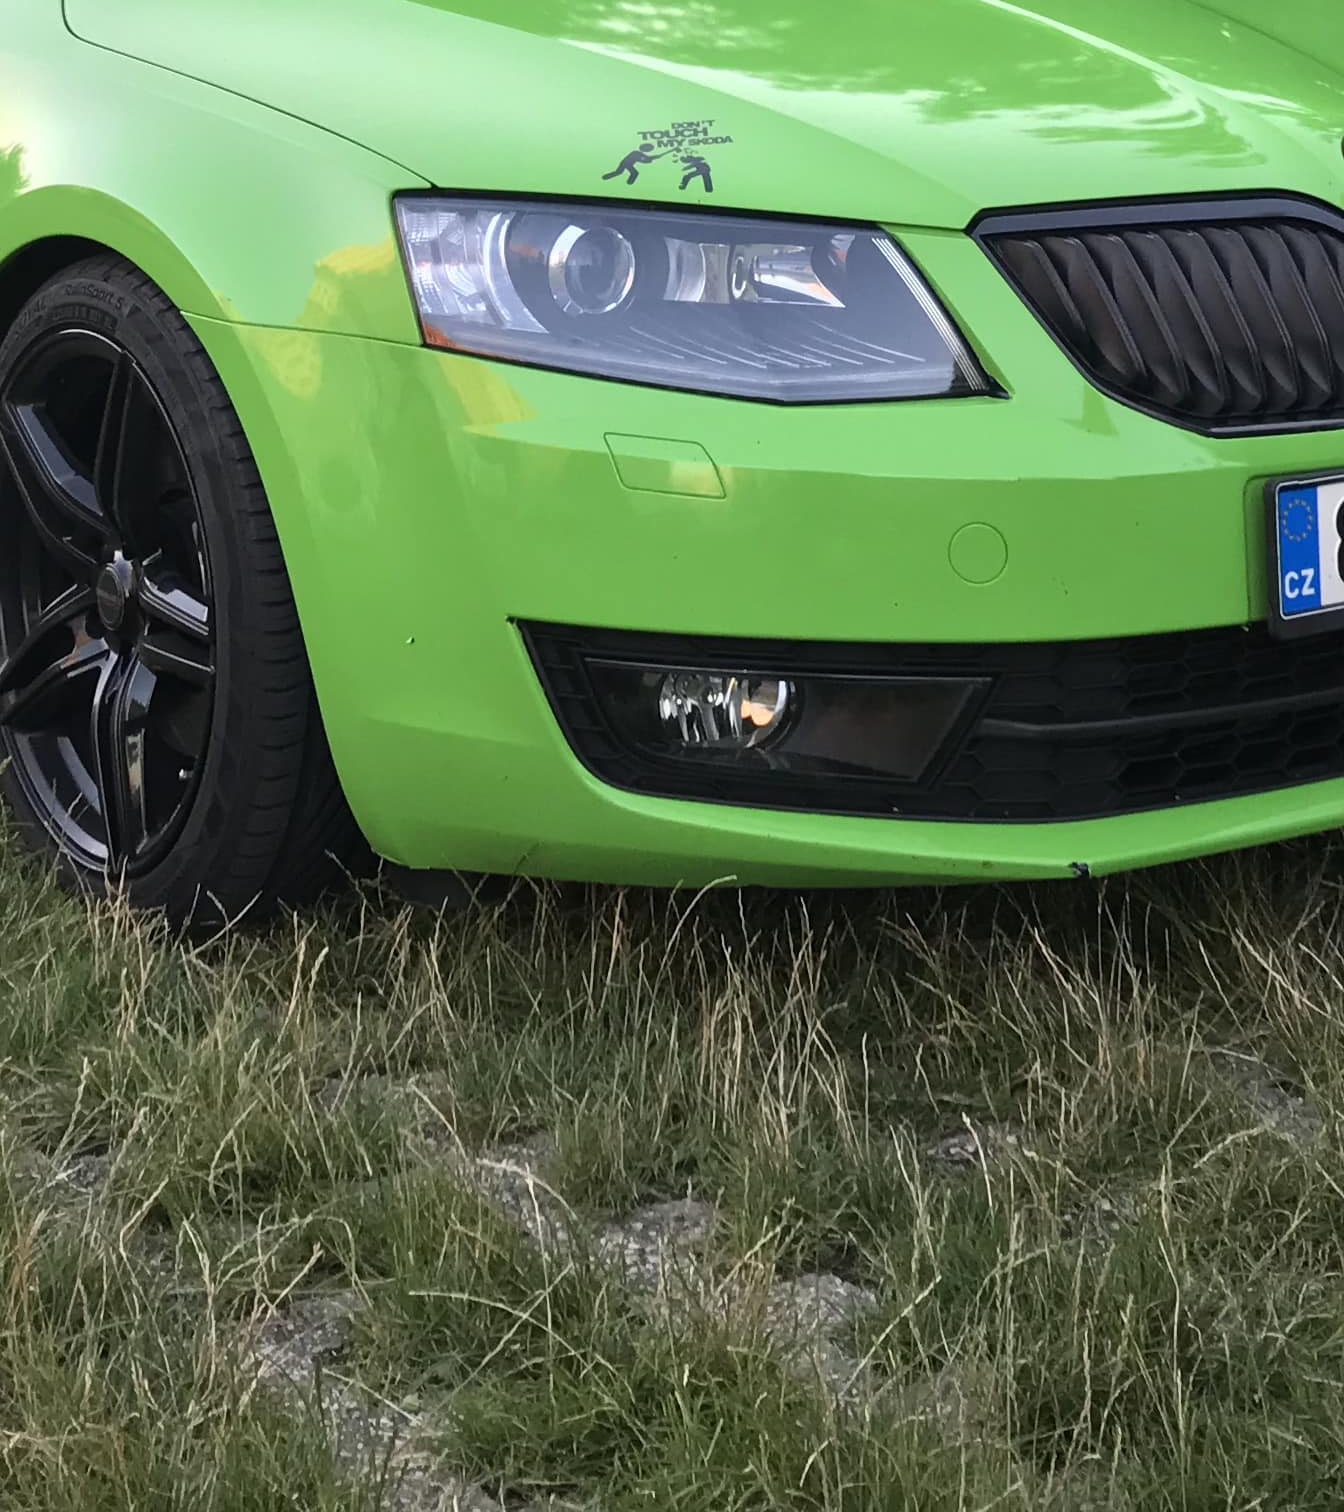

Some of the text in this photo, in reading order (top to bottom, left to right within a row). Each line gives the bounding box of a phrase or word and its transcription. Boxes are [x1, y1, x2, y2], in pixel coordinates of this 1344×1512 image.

[671, 119, 716, 129] DON'T
[637, 127, 709, 141] TOUCH
[657, 135, 734, 148] MY SKODA
[1284, 569, 1316, 599] CZ
